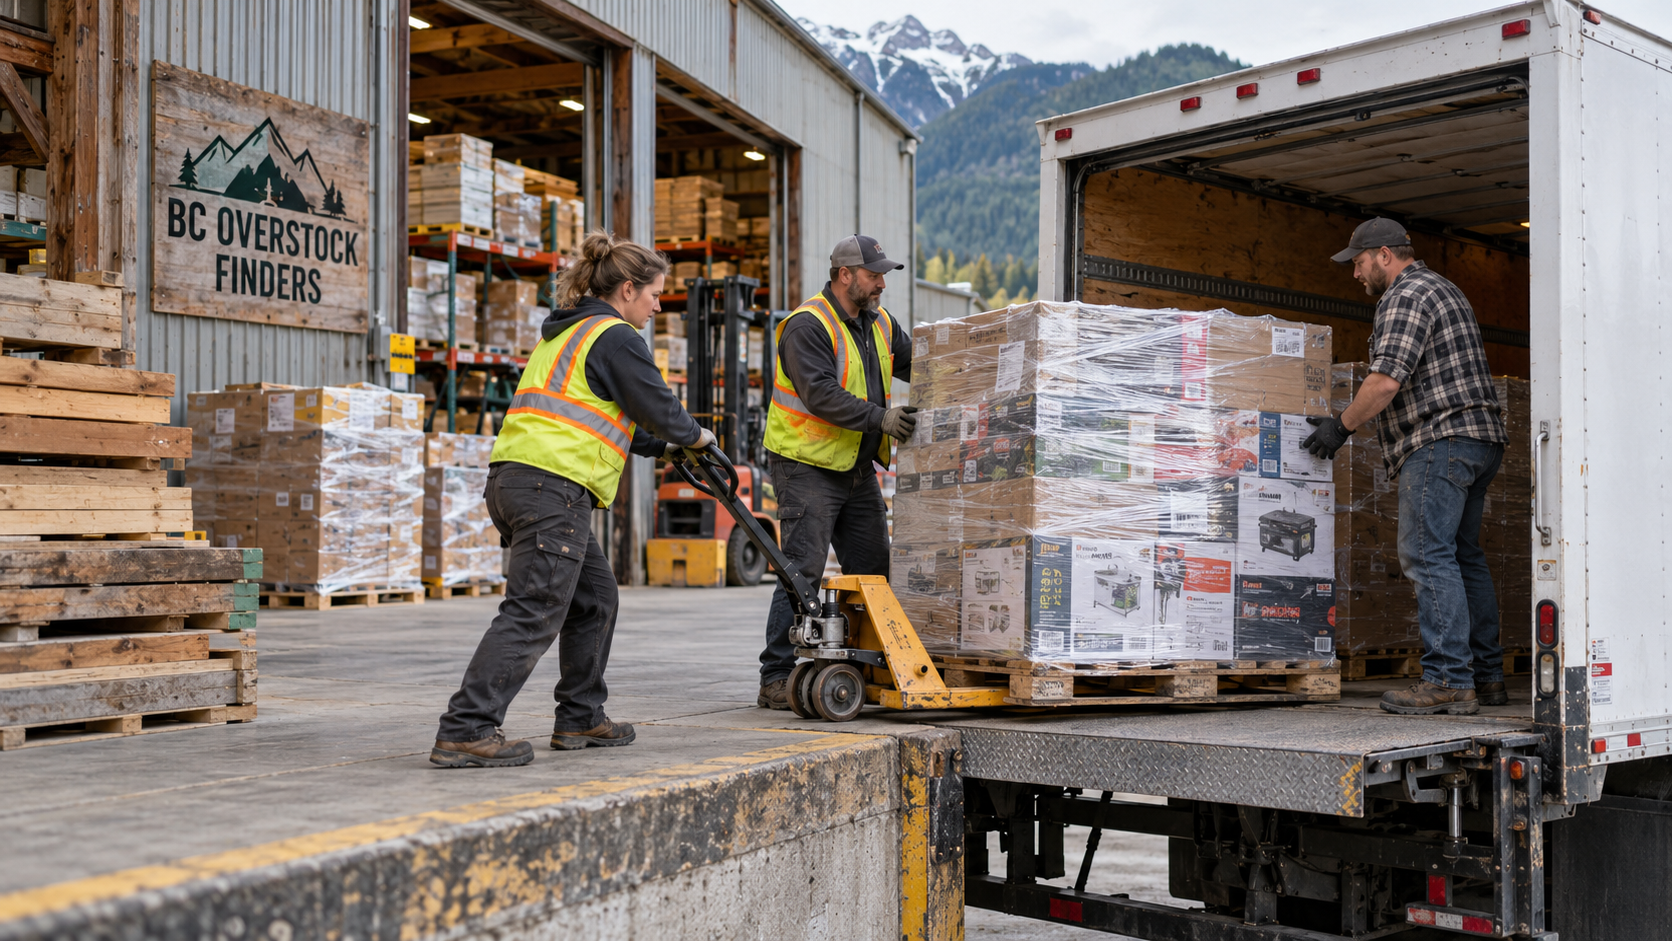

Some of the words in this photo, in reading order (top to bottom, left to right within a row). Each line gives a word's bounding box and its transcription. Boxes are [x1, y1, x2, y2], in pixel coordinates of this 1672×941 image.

[168, 198, 206, 241] BC
[217, 206, 359, 266] OVERSTOCK
[216, 254, 322, 304] FINDERS
